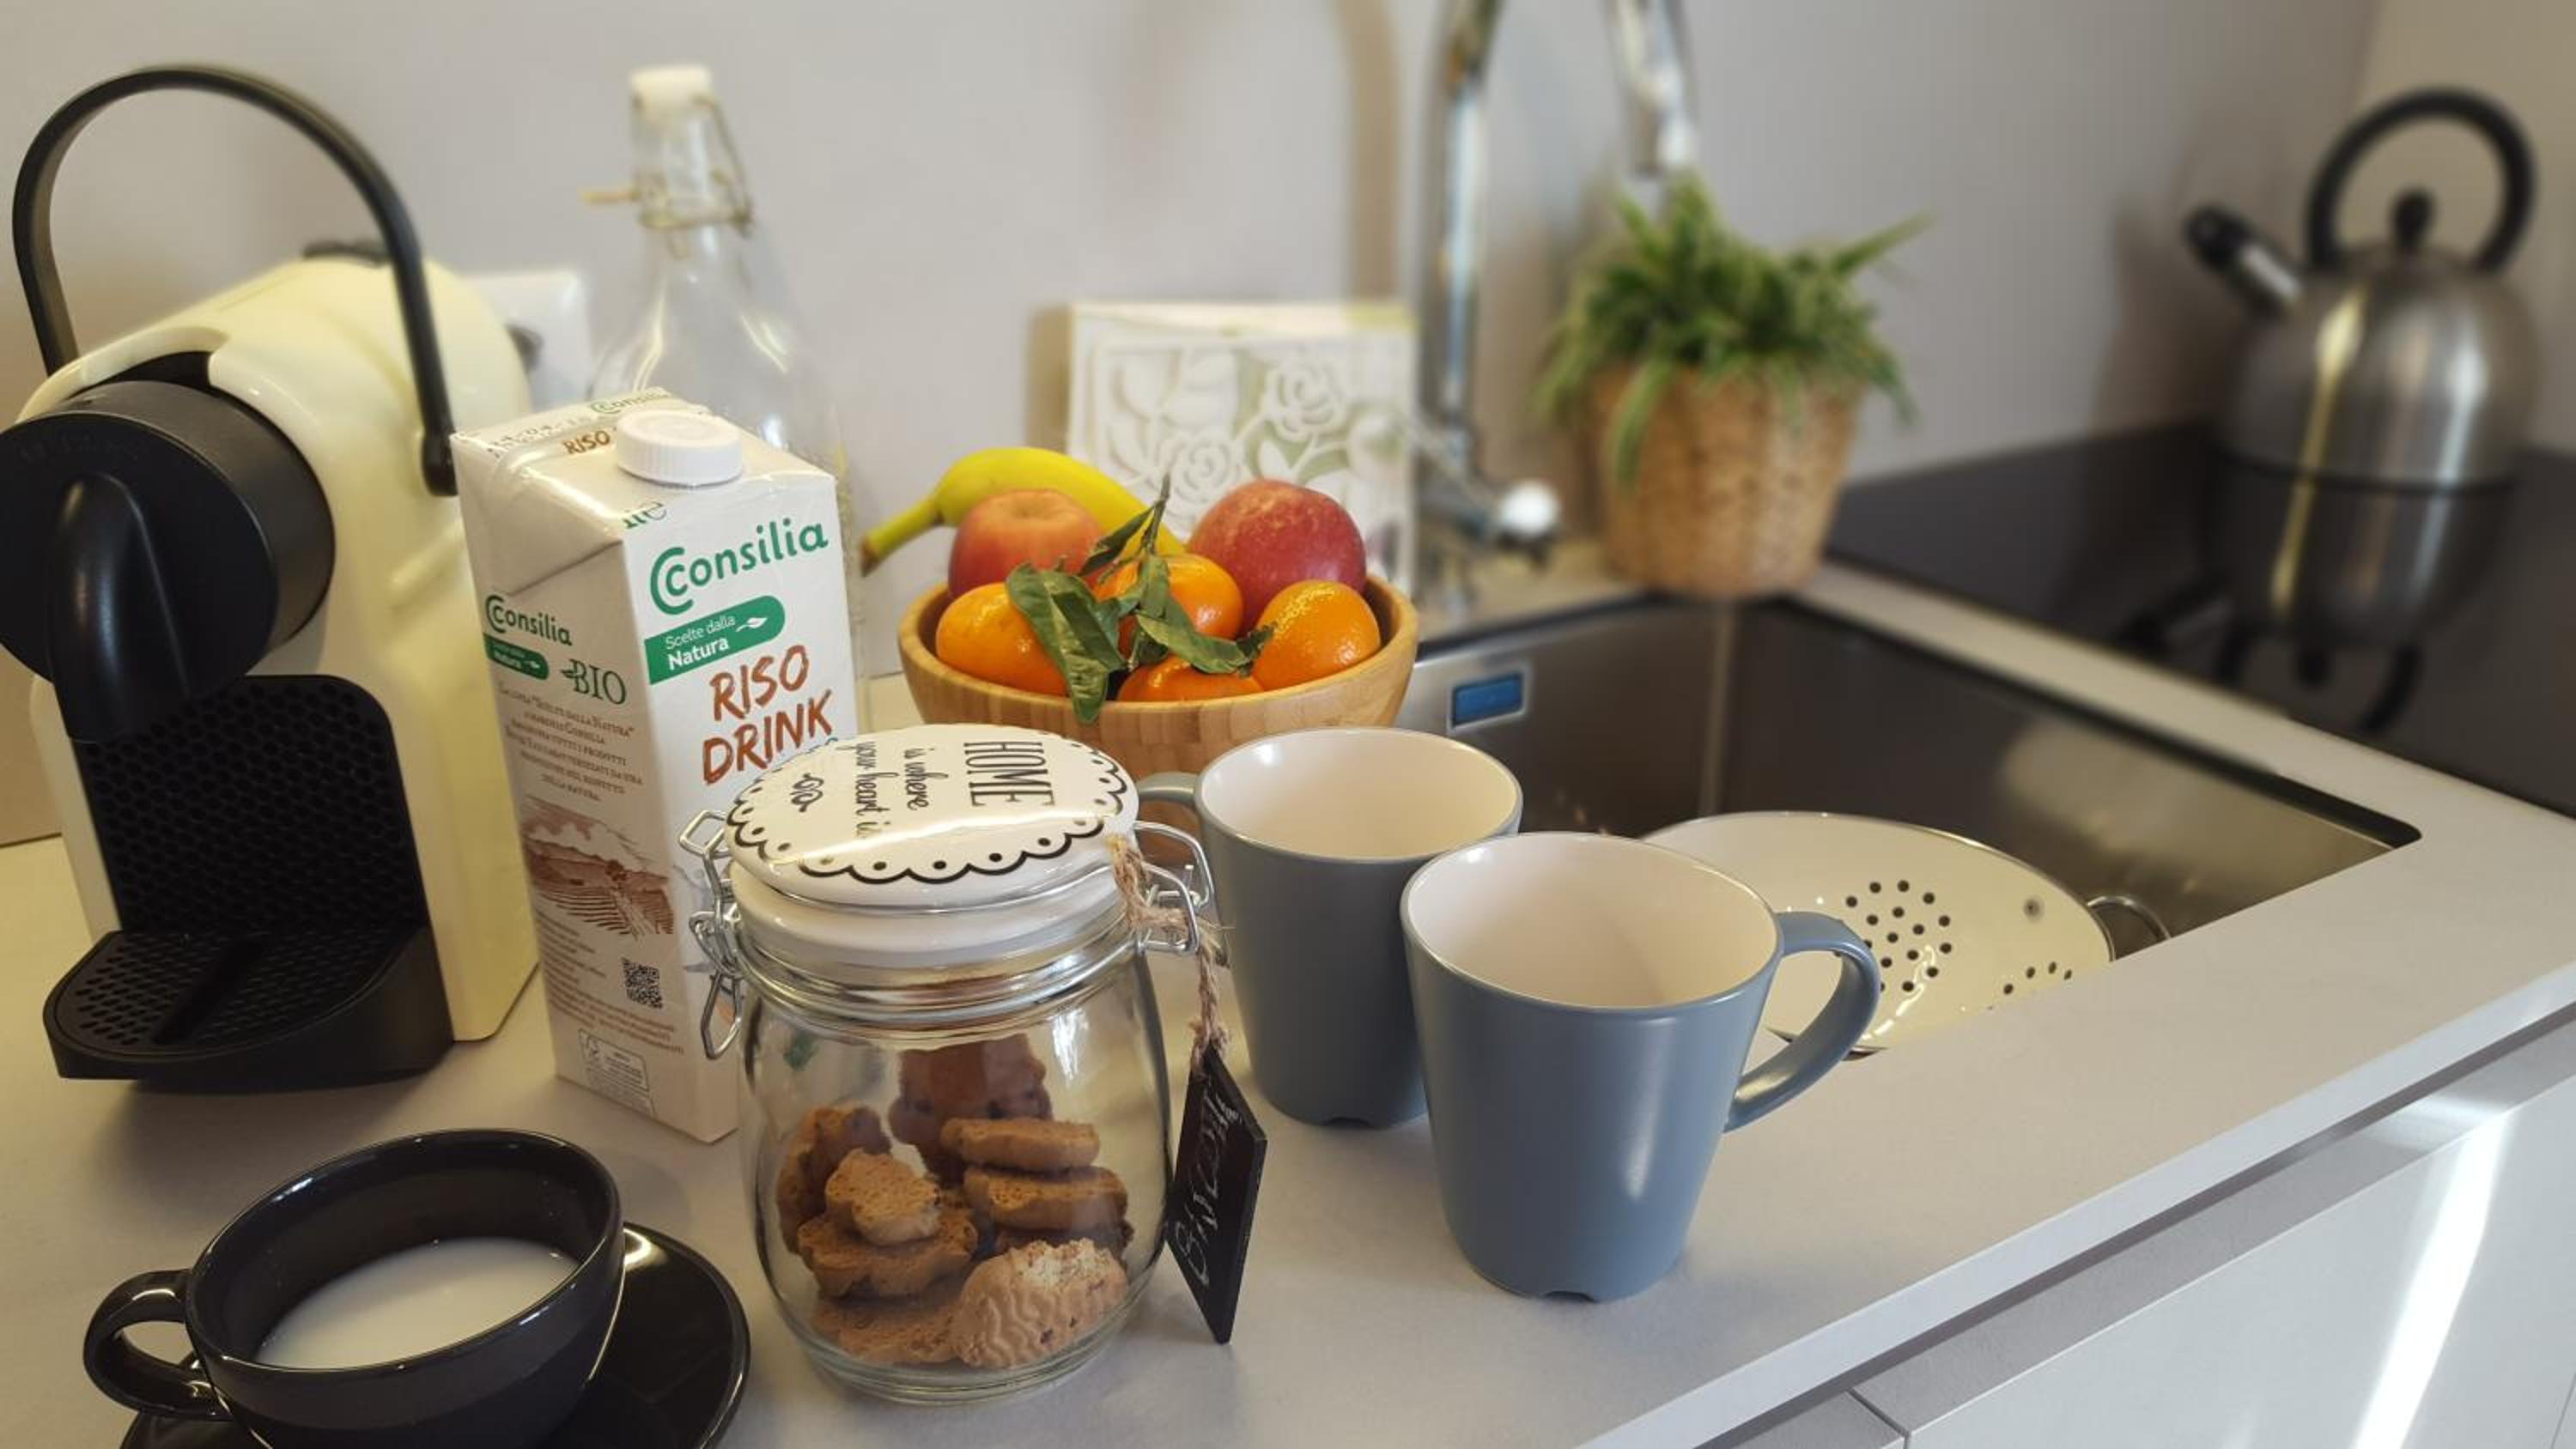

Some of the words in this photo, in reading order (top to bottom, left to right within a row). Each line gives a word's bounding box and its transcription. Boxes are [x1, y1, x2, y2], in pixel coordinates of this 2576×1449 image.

[562, 430, 611, 456] RISO
[665, 626, 704, 651] Scelte
[707, 615, 736, 635] dalla
[667, 637, 730, 670] Natura
[566, 658, 627, 706] BIO
[709, 645, 810, 721] RISO
[702, 689, 832, 785] DRINK
[835, 741, 876, 770] your
[904, 747, 935, 759] is
[855, 773, 899, 815] heart
[904, 761, 949, 810] where
[963, 741, 1055, 807] HOME
